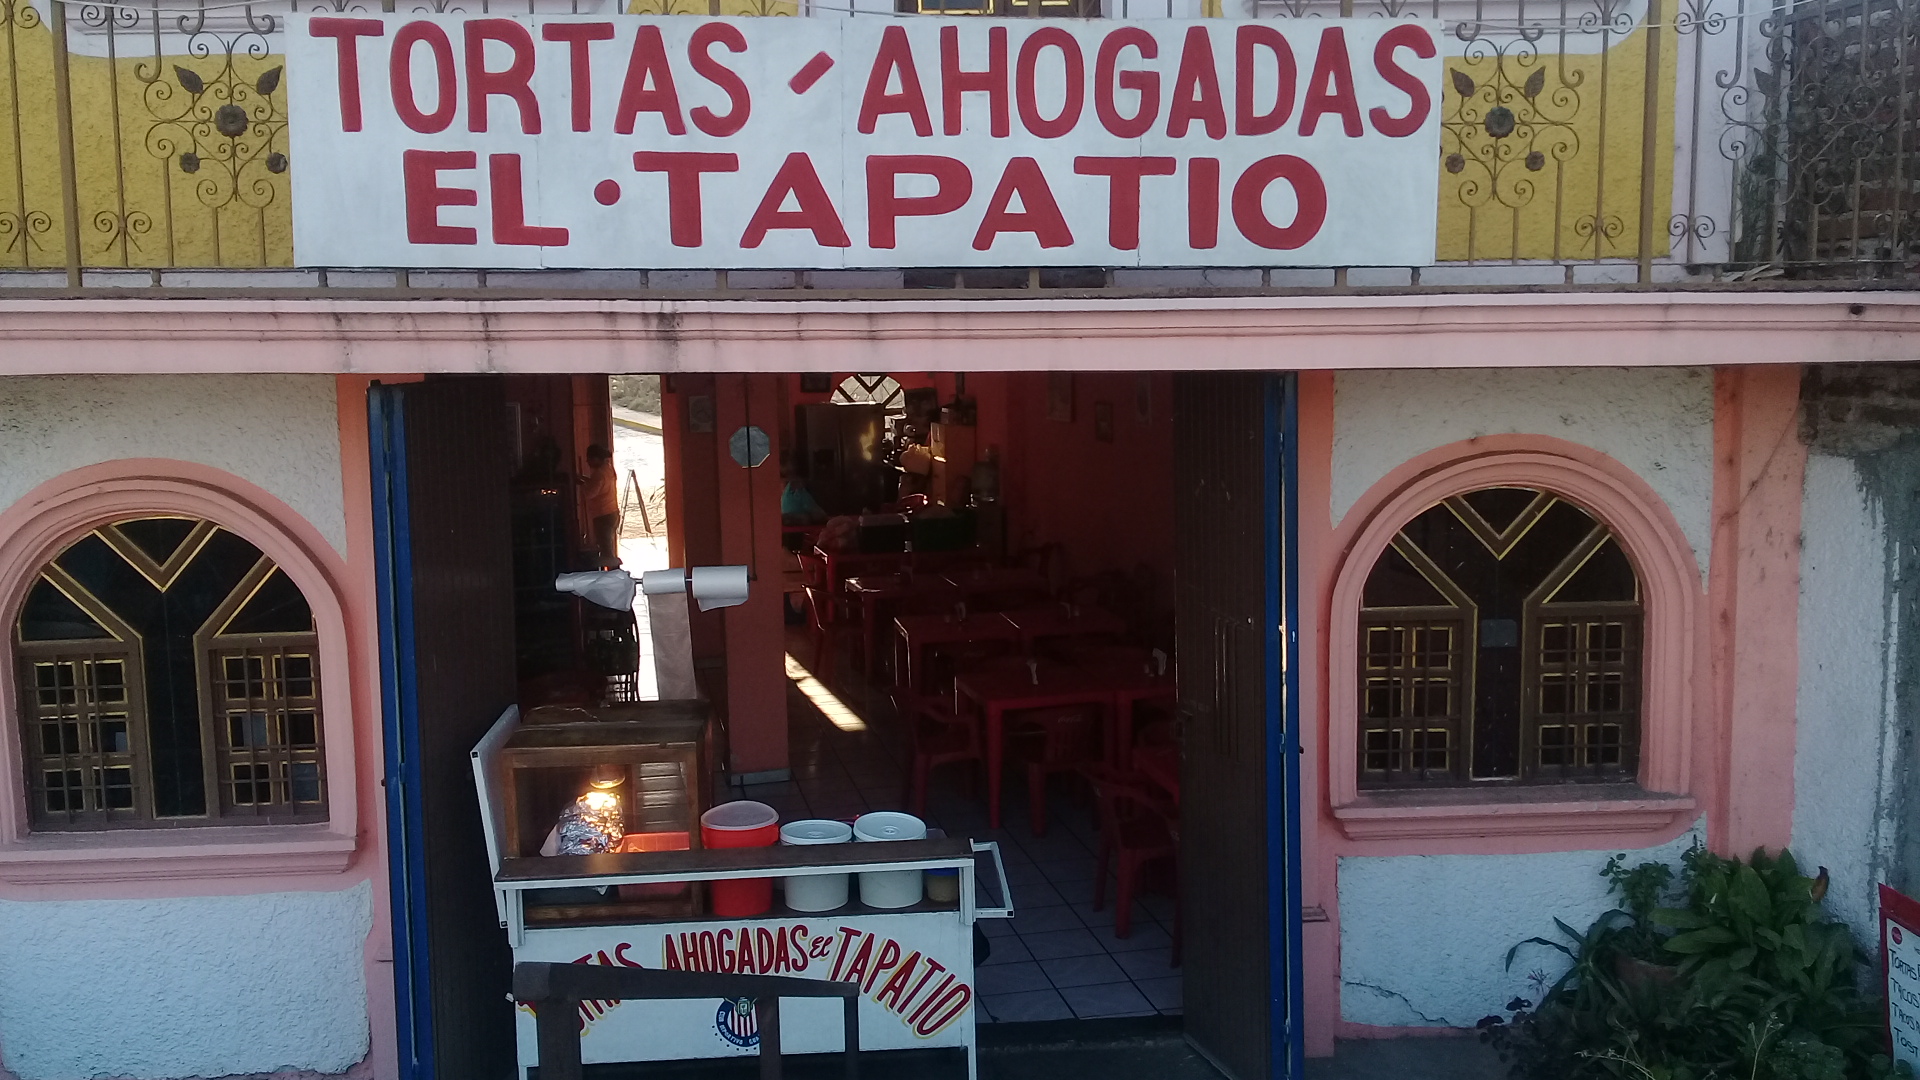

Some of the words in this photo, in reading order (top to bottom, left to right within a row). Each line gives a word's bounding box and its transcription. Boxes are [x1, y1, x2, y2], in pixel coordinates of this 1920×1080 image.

[308, 17, 751, 137] TORTAS
[857, 24, 1437, 140] AHOGADAS
[403, 149, 570, 247] EL
[633, 151, 1327, 250] TAPATIO
[664, 924, 809, 974] AHOGADAS
[830, 926, 972, 1036] TAPATIO
